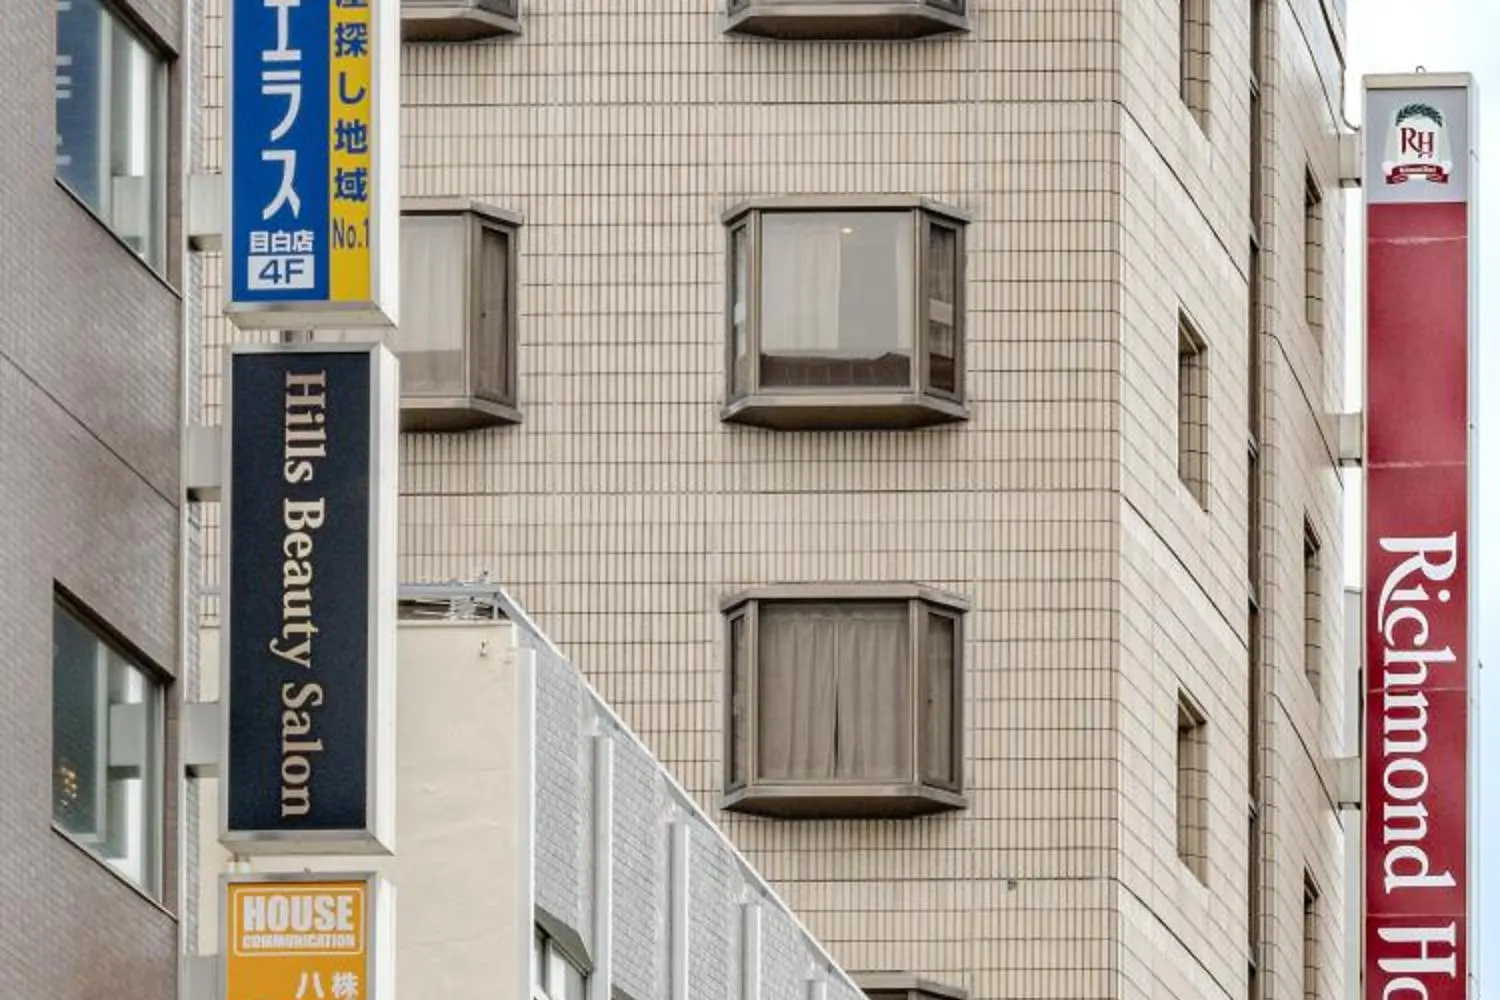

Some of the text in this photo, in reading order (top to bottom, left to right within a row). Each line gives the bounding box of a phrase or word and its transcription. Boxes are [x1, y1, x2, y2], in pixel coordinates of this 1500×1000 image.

[332, 0, 370, 249] 探し地域No.1
[1400, 127, 1435, 159] RH
[249, 229, 315, 253] 目白店
[258, 258, 305, 285] 4F
[269, 370, 327, 818] Hills Beauty Salon
[1377, 531, 1457, 895] Richmond
[243, 894, 355, 932] HOUSE
